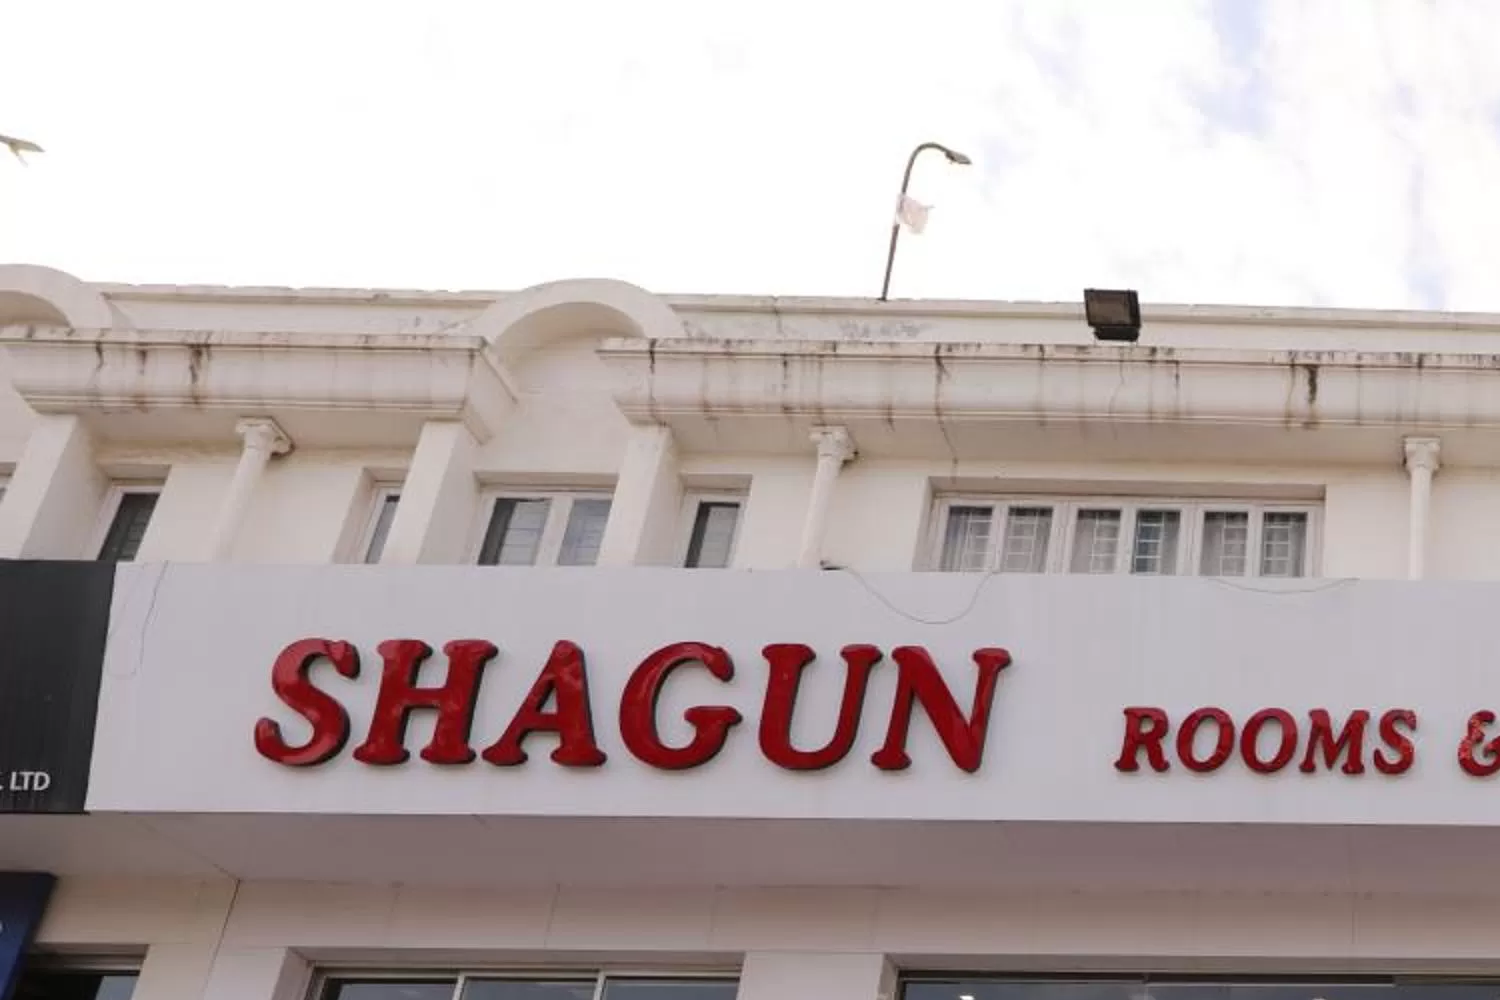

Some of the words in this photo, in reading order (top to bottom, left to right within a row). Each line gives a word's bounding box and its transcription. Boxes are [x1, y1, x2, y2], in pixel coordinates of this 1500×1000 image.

[253, 637, 1013, 773] SHAGUN
[1114, 706, 1418, 774] ROOMS
[9, 771, 51, 791] LTD
